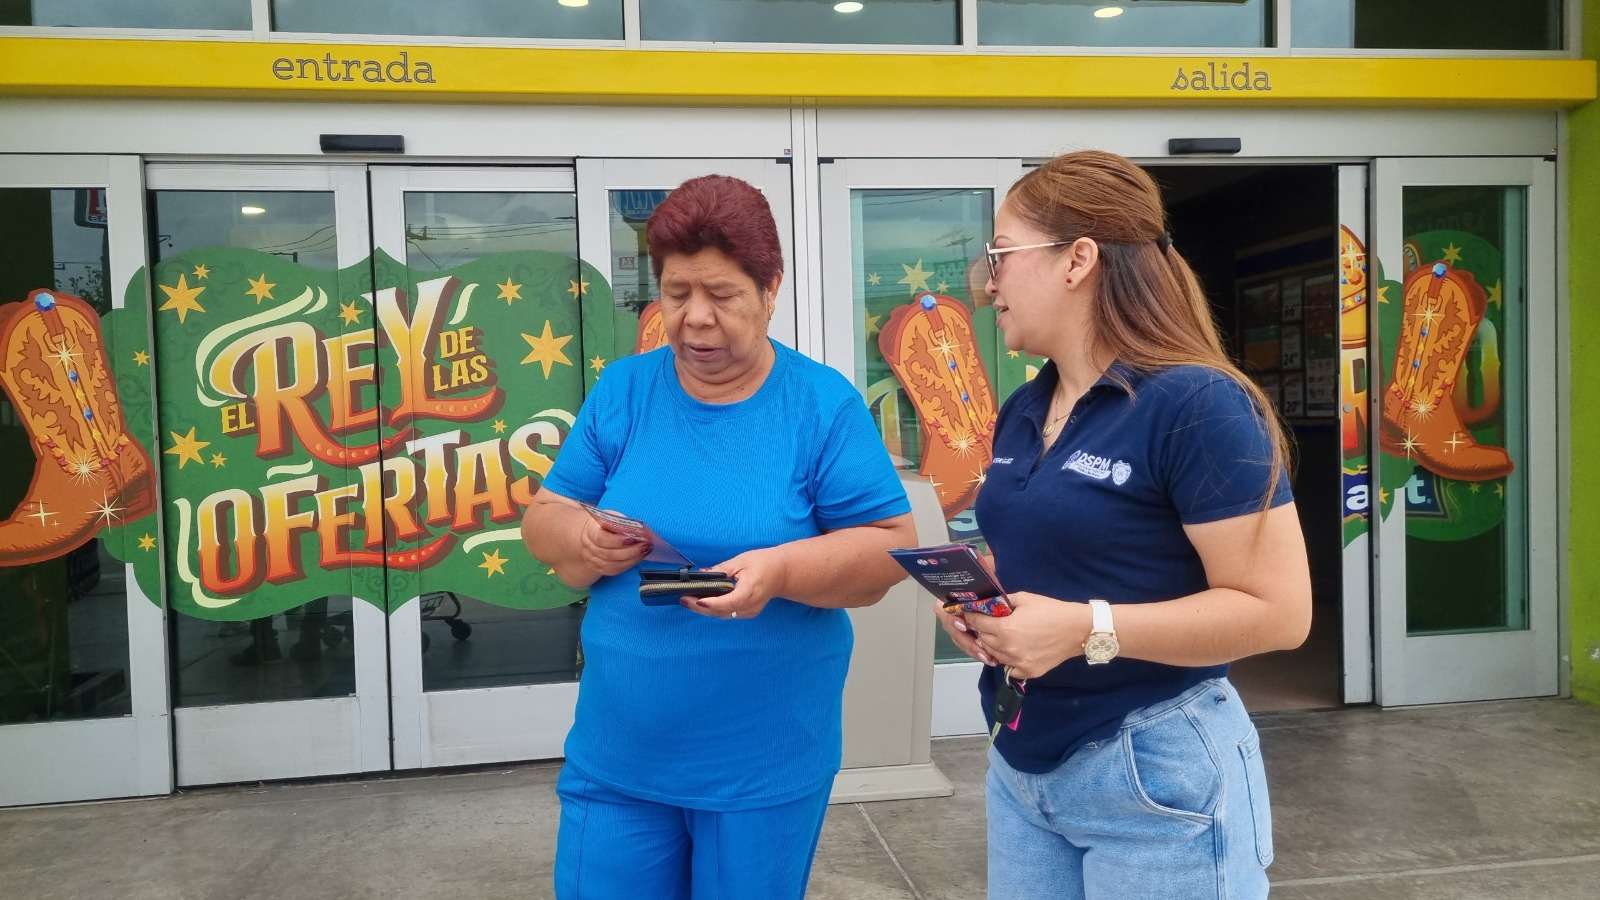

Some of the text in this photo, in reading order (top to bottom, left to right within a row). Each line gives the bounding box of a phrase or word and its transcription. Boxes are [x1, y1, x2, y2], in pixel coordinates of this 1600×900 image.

[272, 51, 437, 84] entrada
[1171, 62, 1272, 91] salida
[438, 326, 476, 359] DE
[209, 275, 498, 466] REY
[431, 354, 489, 392] LAS
[220, 402, 256, 434] EL
[1078, 452, 1112, 471] DSPM
[197, 420, 561, 593] OFERTAS
